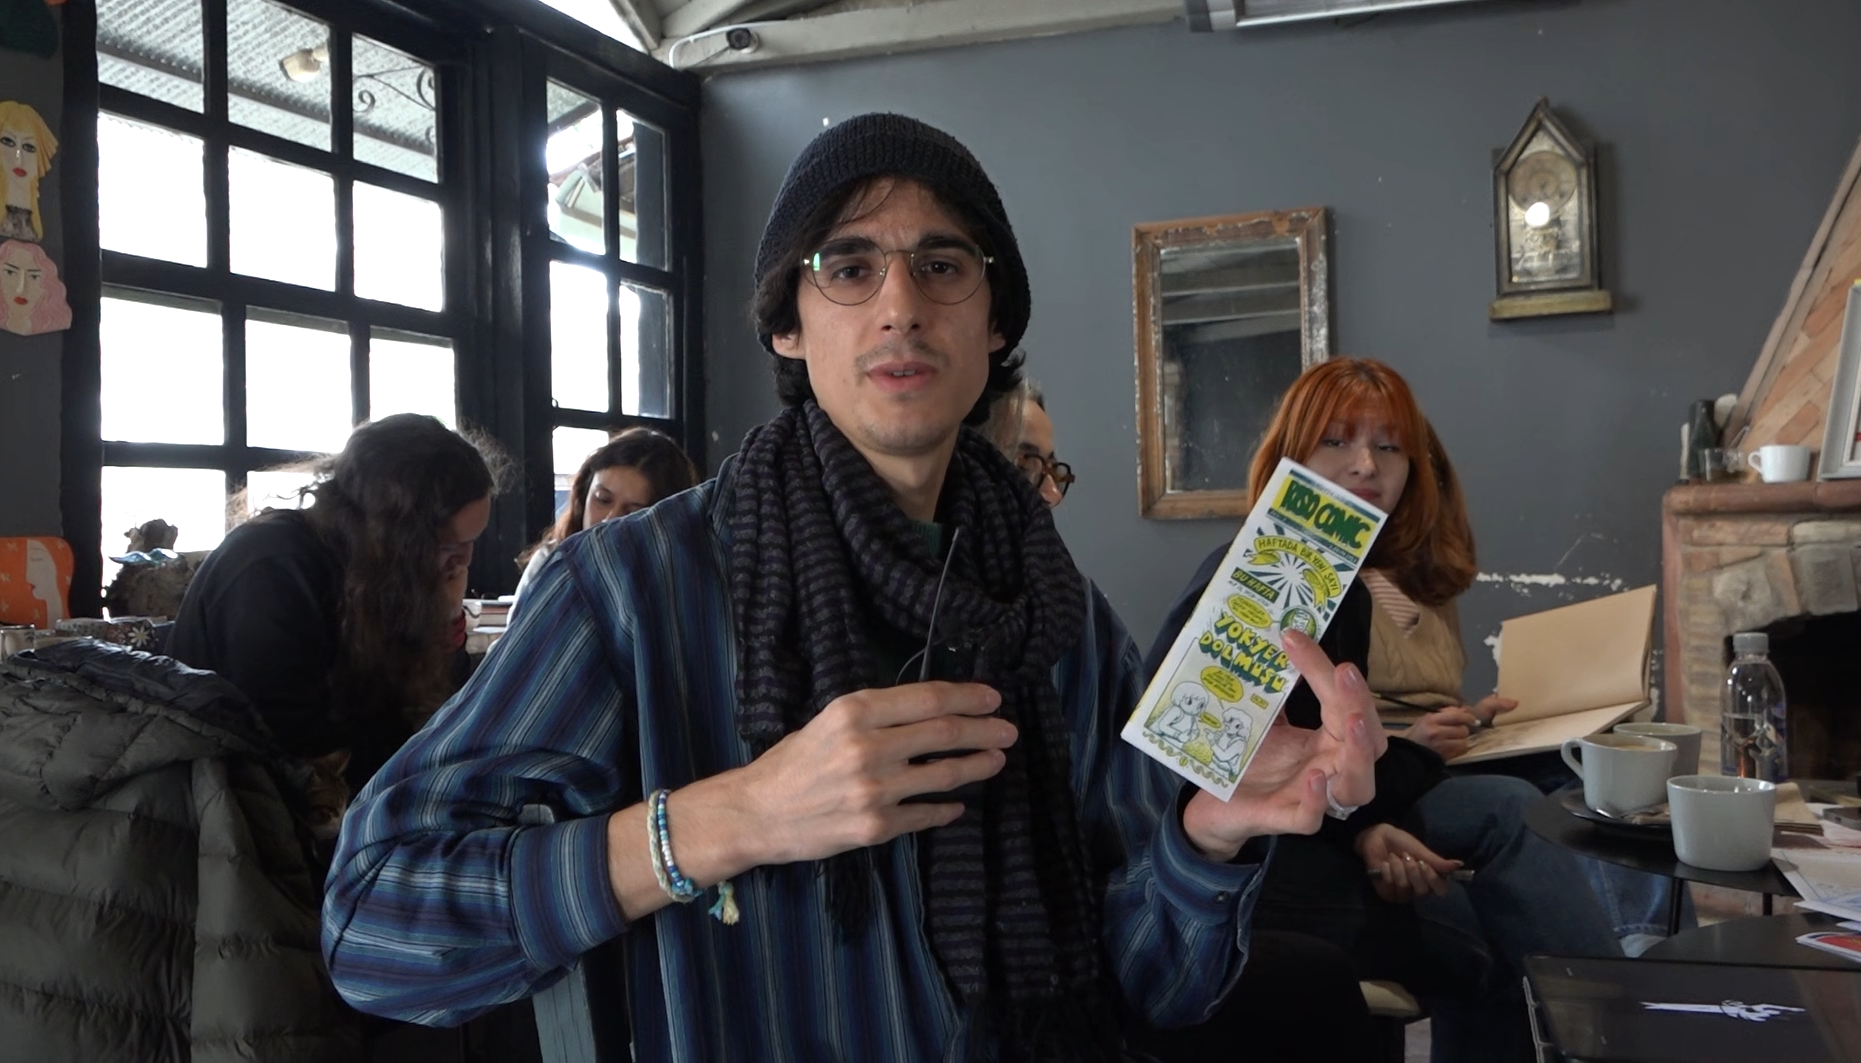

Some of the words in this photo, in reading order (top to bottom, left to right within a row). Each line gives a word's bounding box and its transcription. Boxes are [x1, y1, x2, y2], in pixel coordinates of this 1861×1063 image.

[1315, 503, 1370, 549] COMIC
[1232, 569, 1247, 583] BU
[1246, 578, 1275, 599] HAFTA
[1258, 538, 1298, 552] HAFTADA
[1324, 573, 1338, 590] SAYI
[1214, 612, 1288, 671] YOKYER
